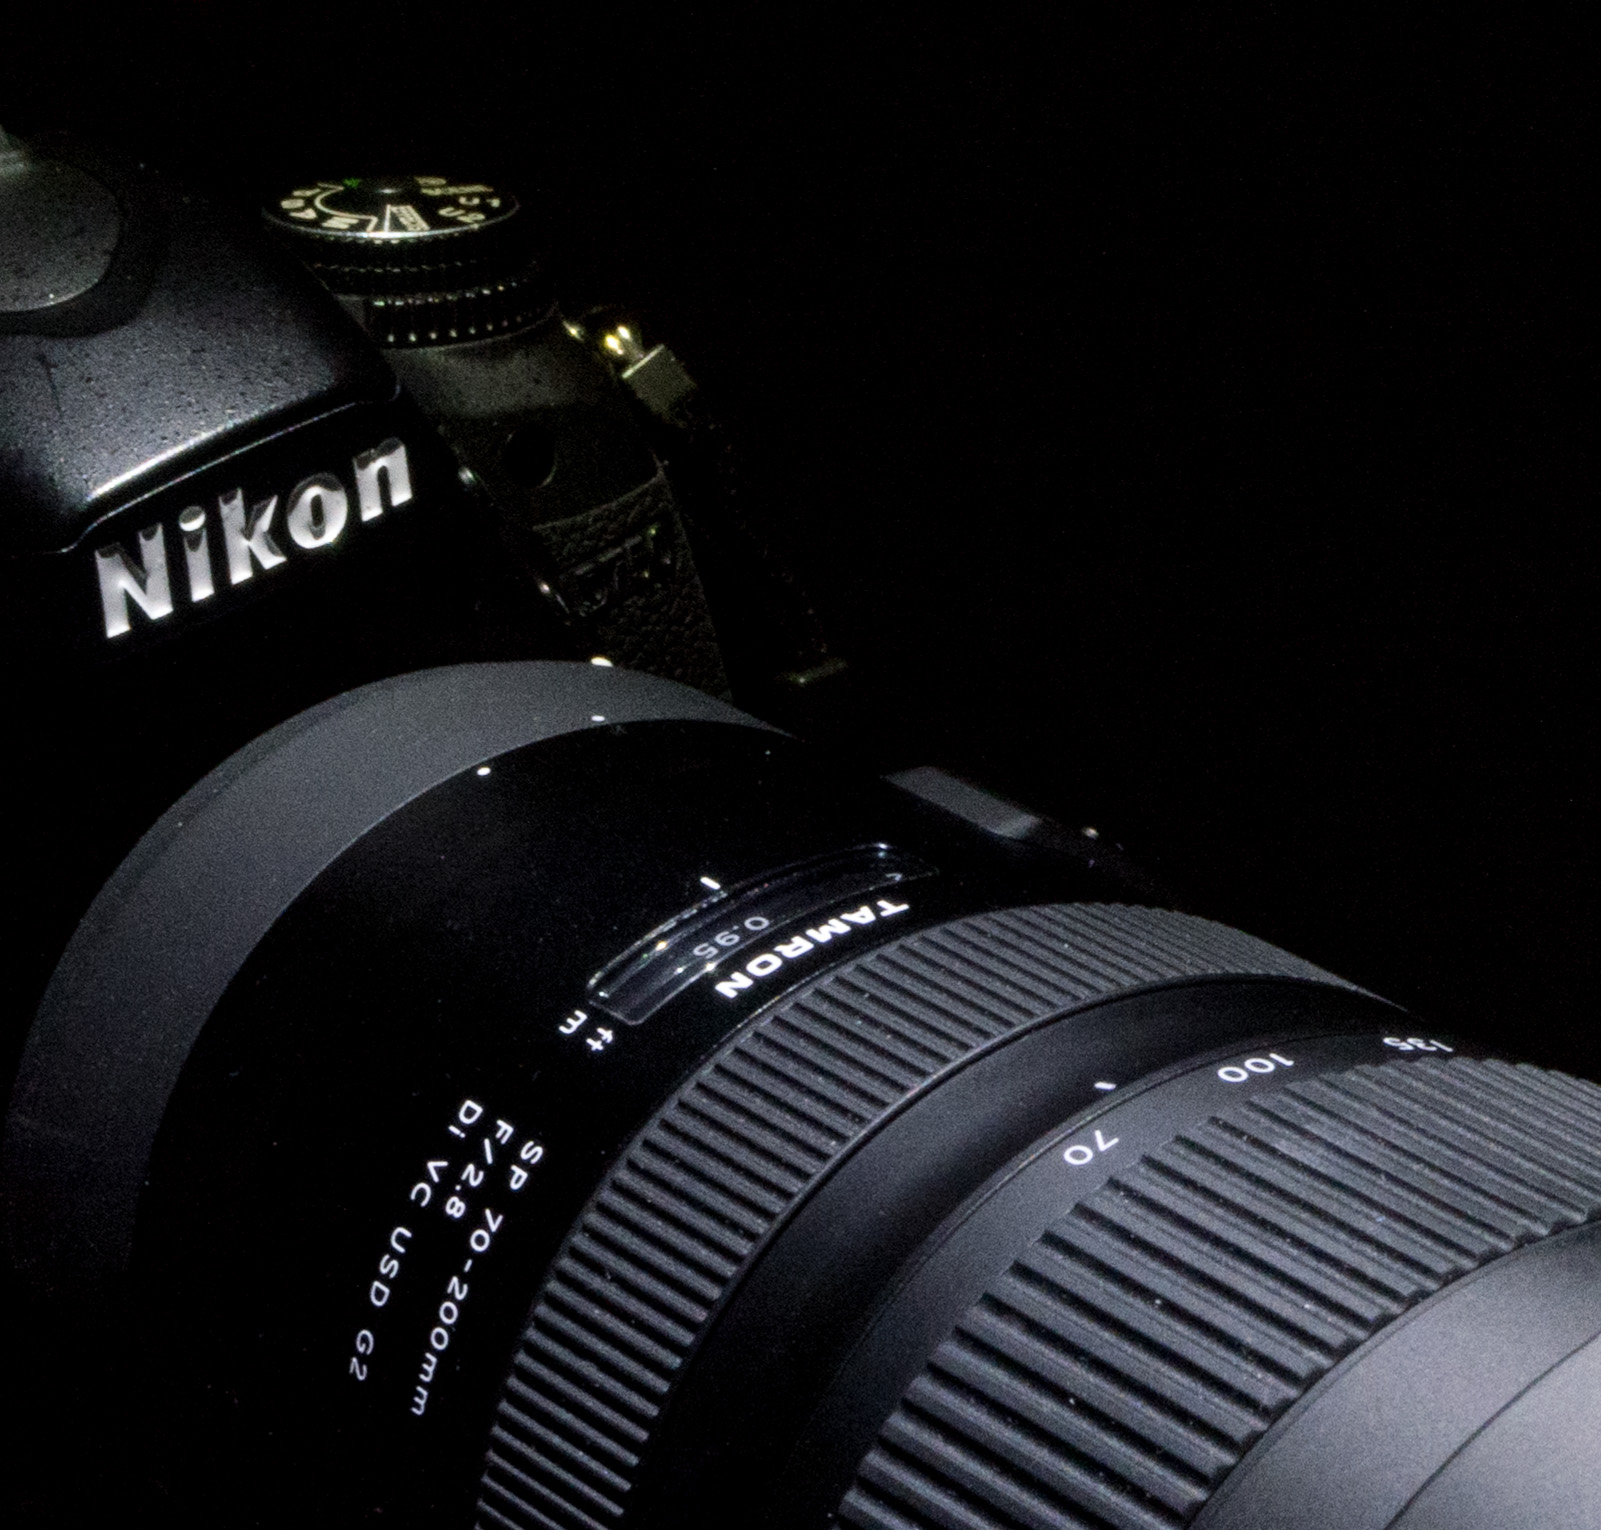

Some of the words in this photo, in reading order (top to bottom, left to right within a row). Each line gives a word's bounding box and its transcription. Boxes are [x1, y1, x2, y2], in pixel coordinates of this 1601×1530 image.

[95, 436, 413, 639] Nikon
[691, 915, 771, 960] 0.95
[714, 899, 910, 999] TAMRON
[558, 1009, 588, 1035] m
[585, 1027, 614, 1052] ft
[1382, 1037, 1453, 1054] 135
[1217, 1053, 1294, 1083] 100
[448, 1099, 484, 1139] Di
[444, 1119, 515, 1219] F/2.8
[509, 1140, 544, 1191] SP
[1062, 1129, 1119, 1167] 70
[409, 1160, 449, 1208] VC
[369, 1226, 413, 1308] USD
[411, 1207, 504, 1416] 70-200mm
[349, 1329, 374, 1381] G2
